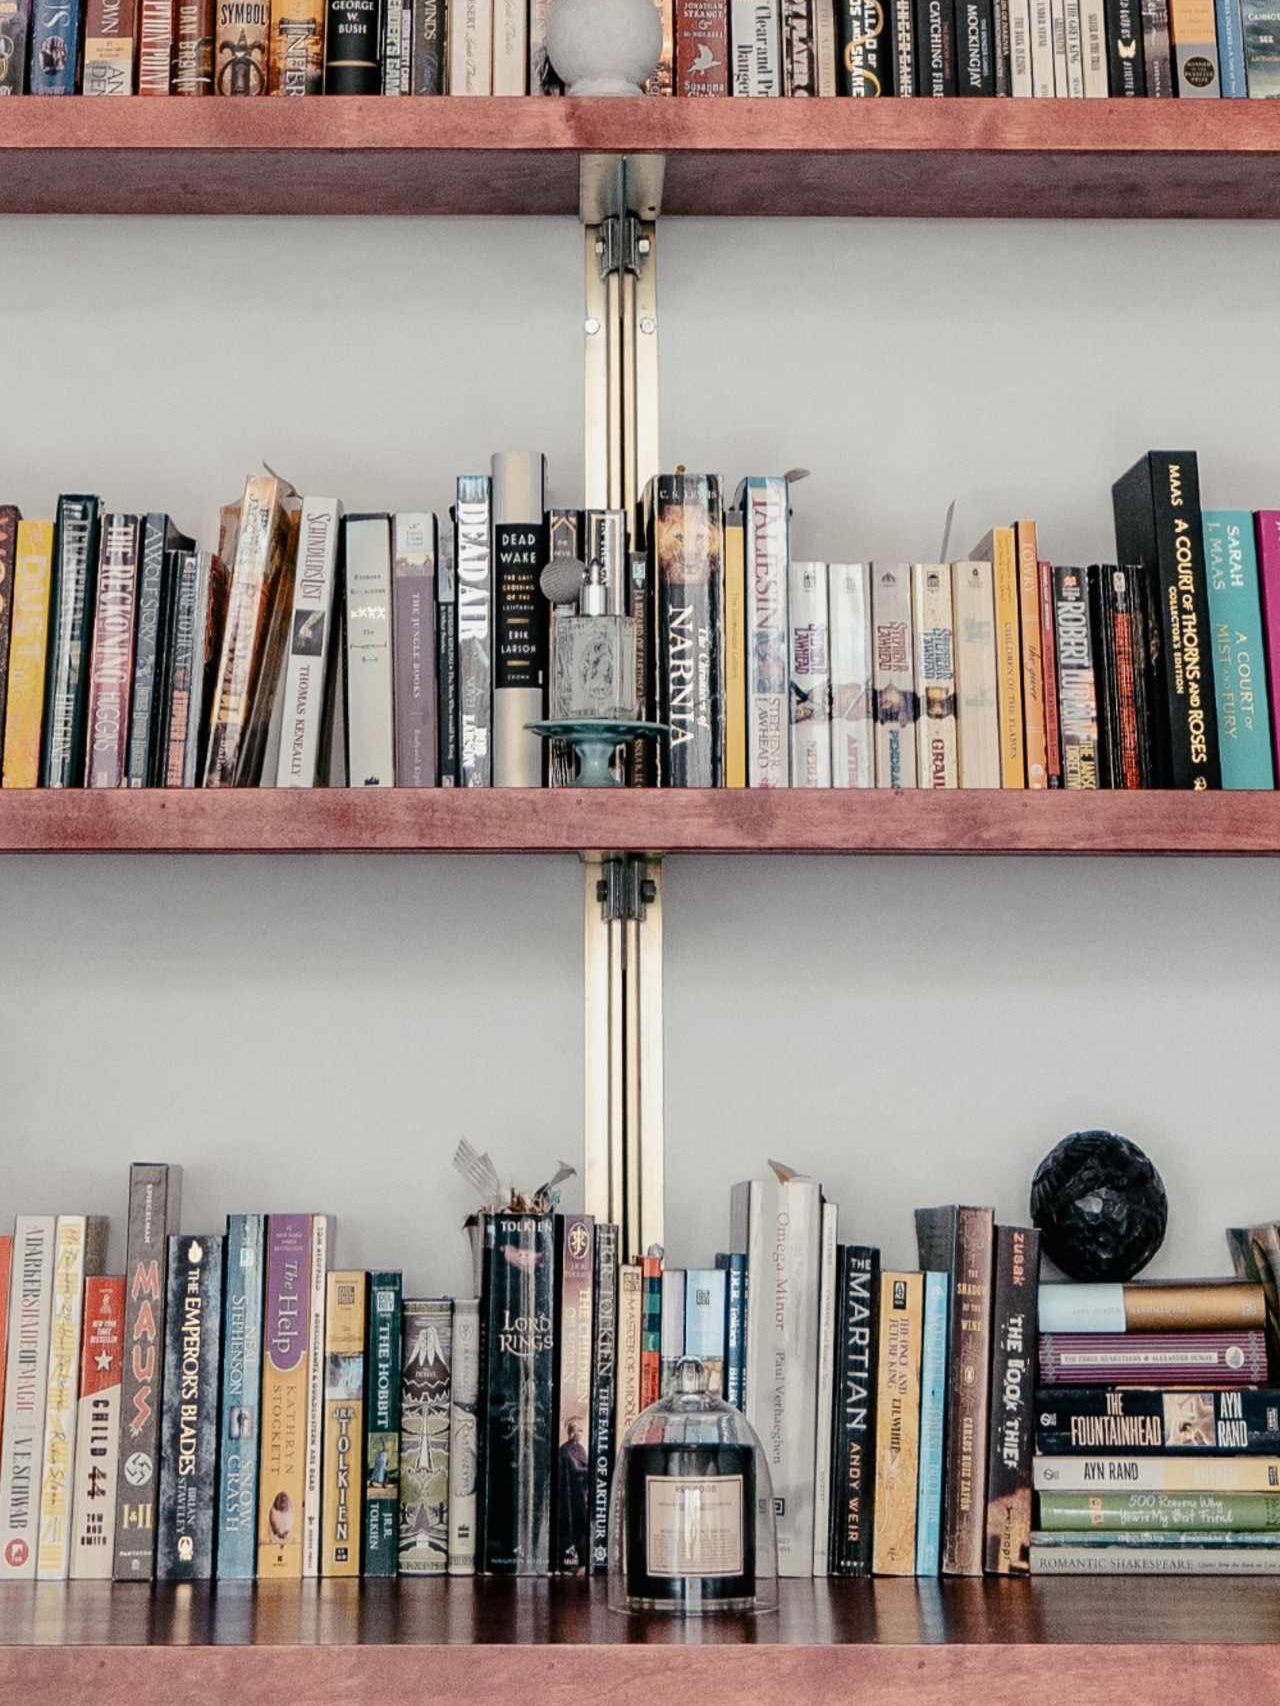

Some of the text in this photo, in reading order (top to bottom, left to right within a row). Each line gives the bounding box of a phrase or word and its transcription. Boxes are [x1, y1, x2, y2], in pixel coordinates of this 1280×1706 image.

[179, 5, 198, 34] DAN
[220, 3, 267, 26] SYMBOL
[331, 0, 374, 10] GEORGE
[338, 24, 367, 35] BUSH
[852, 20, 863, 41] AND
[929, 0, 944, 68] CATCHING
[140, 48, 169, 92] POINT
[177, 40, 197, 92] BROWN
[867, 53, 877, 68] OF
[966, 4, 982, 88] MOCKINGJAY
[456, 499, 489, 643] DEAD AIR
[500, 552, 537, 564] WAKE
[502, 533, 536, 546] DEAD
[752, 498, 782, 629] TALIESIN
[94, 523, 135, 684] THE RECKONING
[299, 579, 327, 603] LIST
[409, 592, 422, 699] THE JUNGLE BOOKS
[1168, 587, 1184, 694] COLLECTOR'S EDITION
[1174, 518, 1207, 763] A COURT OF THORNS AND ROSES
[295, 665, 311, 715] THOMAS
[668, 603, 695, 749] NARNIA
[289, 719, 306, 777] KENEALLY
[851, 1257, 871, 1270] THE
[1012, 1231, 1027, 1285] zusak
[275, 1260, 300, 1353] The Help
[503, 1309, 552, 1334] LORD
[770, 1211, 790, 1464] Omega Minor Paul Verhaeghen
[129, 1260, 160, 1439] MAUS
[177, 1267, 201, 1476] THE EMPEROR'S BLADES
[228, 1294, 247, 1395] STEPHENSON
[375, 1323, 391, 1428] THE HOBBIT
[500, 1333, 554, 1357] RINGS
[845, 1270, 870, 1541] MARTIAN ANDY WEIR
[1001, 1313, 1026, 1469] THE BOOK THIEF
[1104, 1393, 1124, 1416] THE
[1219, 1392, 1242, 1418] AYN
[89, 1398, 111, 1500] CHILD 44
[269, 1384, 284, 1475] STOCKETT
[284, 1384, 297, 1475] KATHRYN
[1070, 1417, 1162, 1447] FOUNTAINHEAD
[1217, 1420, 1248, 1448] RAND
[225, 1454, 241, 1532] CRASH
[594, 1386, 609, 1538] THE FALL OF ARTHUR
[1083, 1462, 1139, 1481] AYN RAND
[239, 1459, 254, 1529] SNOW
[368, 1503, 380, 1550] TOLKIEN
